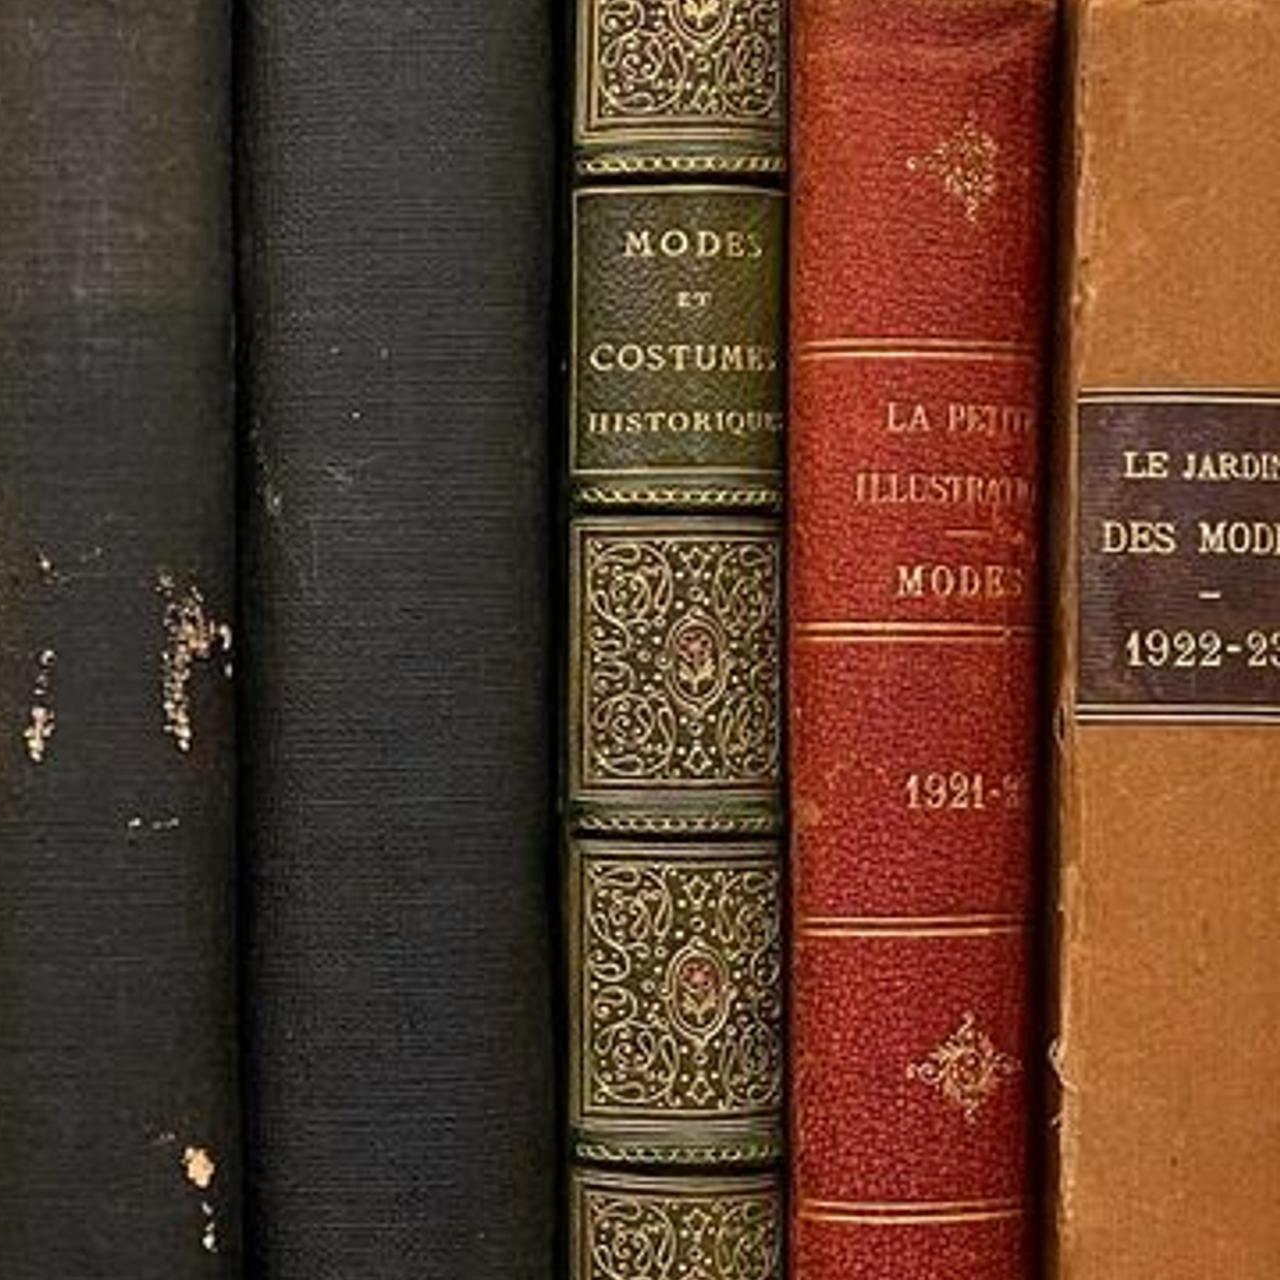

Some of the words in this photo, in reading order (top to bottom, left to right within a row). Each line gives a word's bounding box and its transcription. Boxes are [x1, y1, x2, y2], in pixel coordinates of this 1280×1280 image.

[623, 229, 764, 259] MODES
[675, 290, 713, 308] ET
[886, 399, 931, 433] LA
[1122, 451, 1172, 479] LE
[1101, 521, 1178, 554] DES
[894, 565, 1024, 598] MODES
